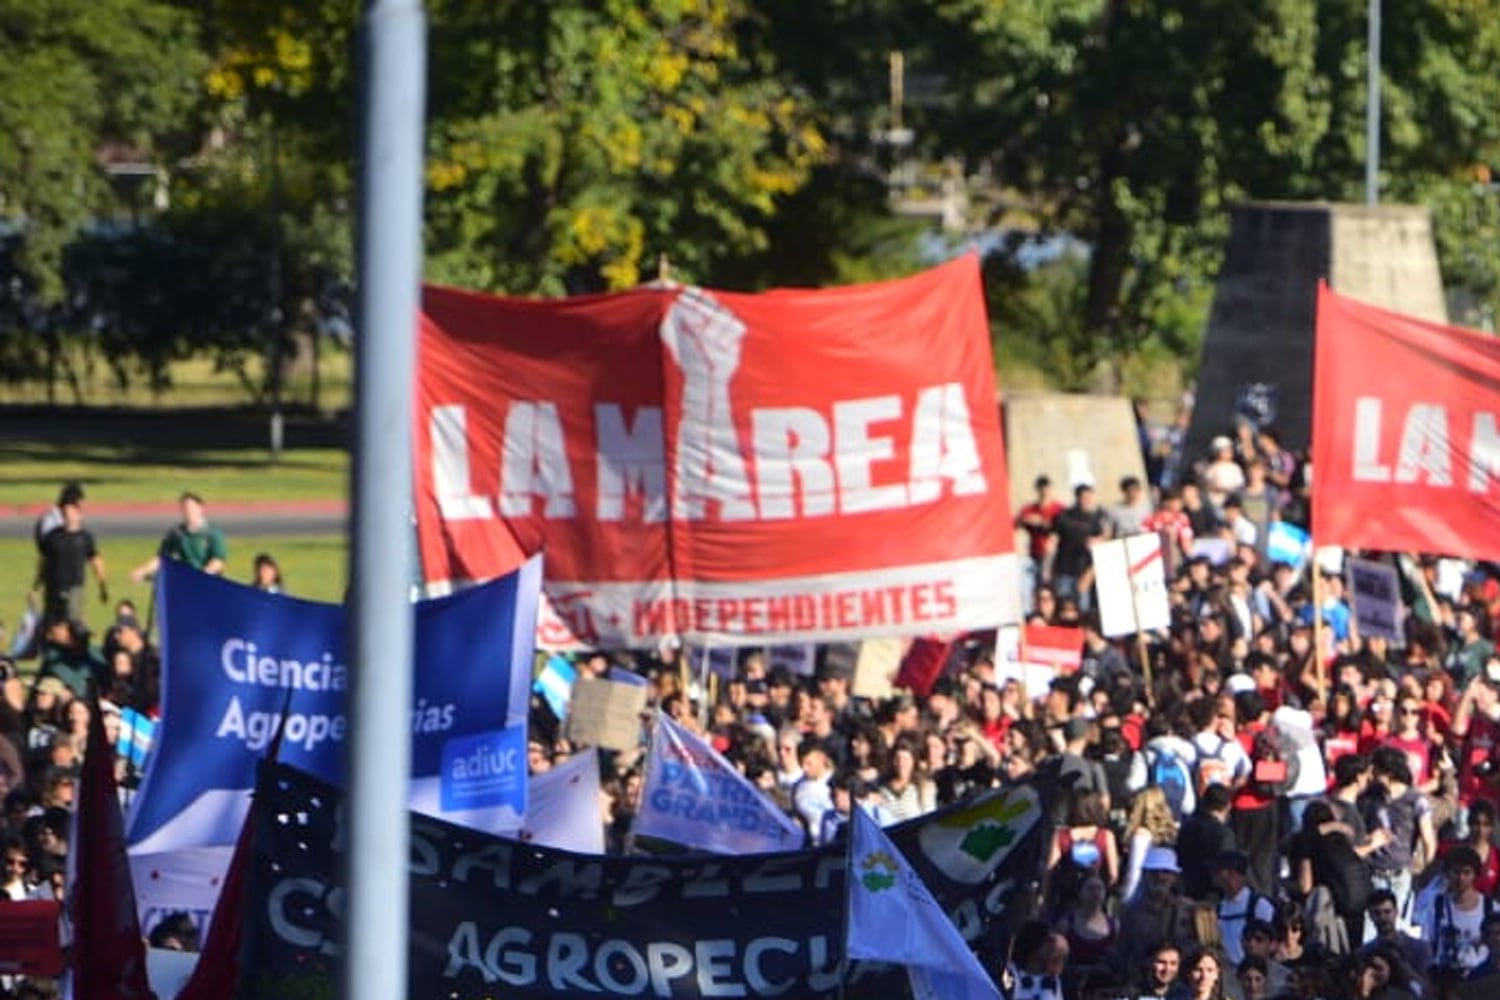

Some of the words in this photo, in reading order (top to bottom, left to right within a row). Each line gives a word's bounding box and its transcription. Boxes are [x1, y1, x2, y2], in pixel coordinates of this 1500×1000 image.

[430, 400, 576, 521] LA
[594, 383, 988, 522] MAREA
[1352, 396, 1454, 487] LA
[633, 580, 958, 638] INDEPENDIENTES
[220, 637, 349, 693] Ciencia
[451, 745, 519, 781] adiuc
